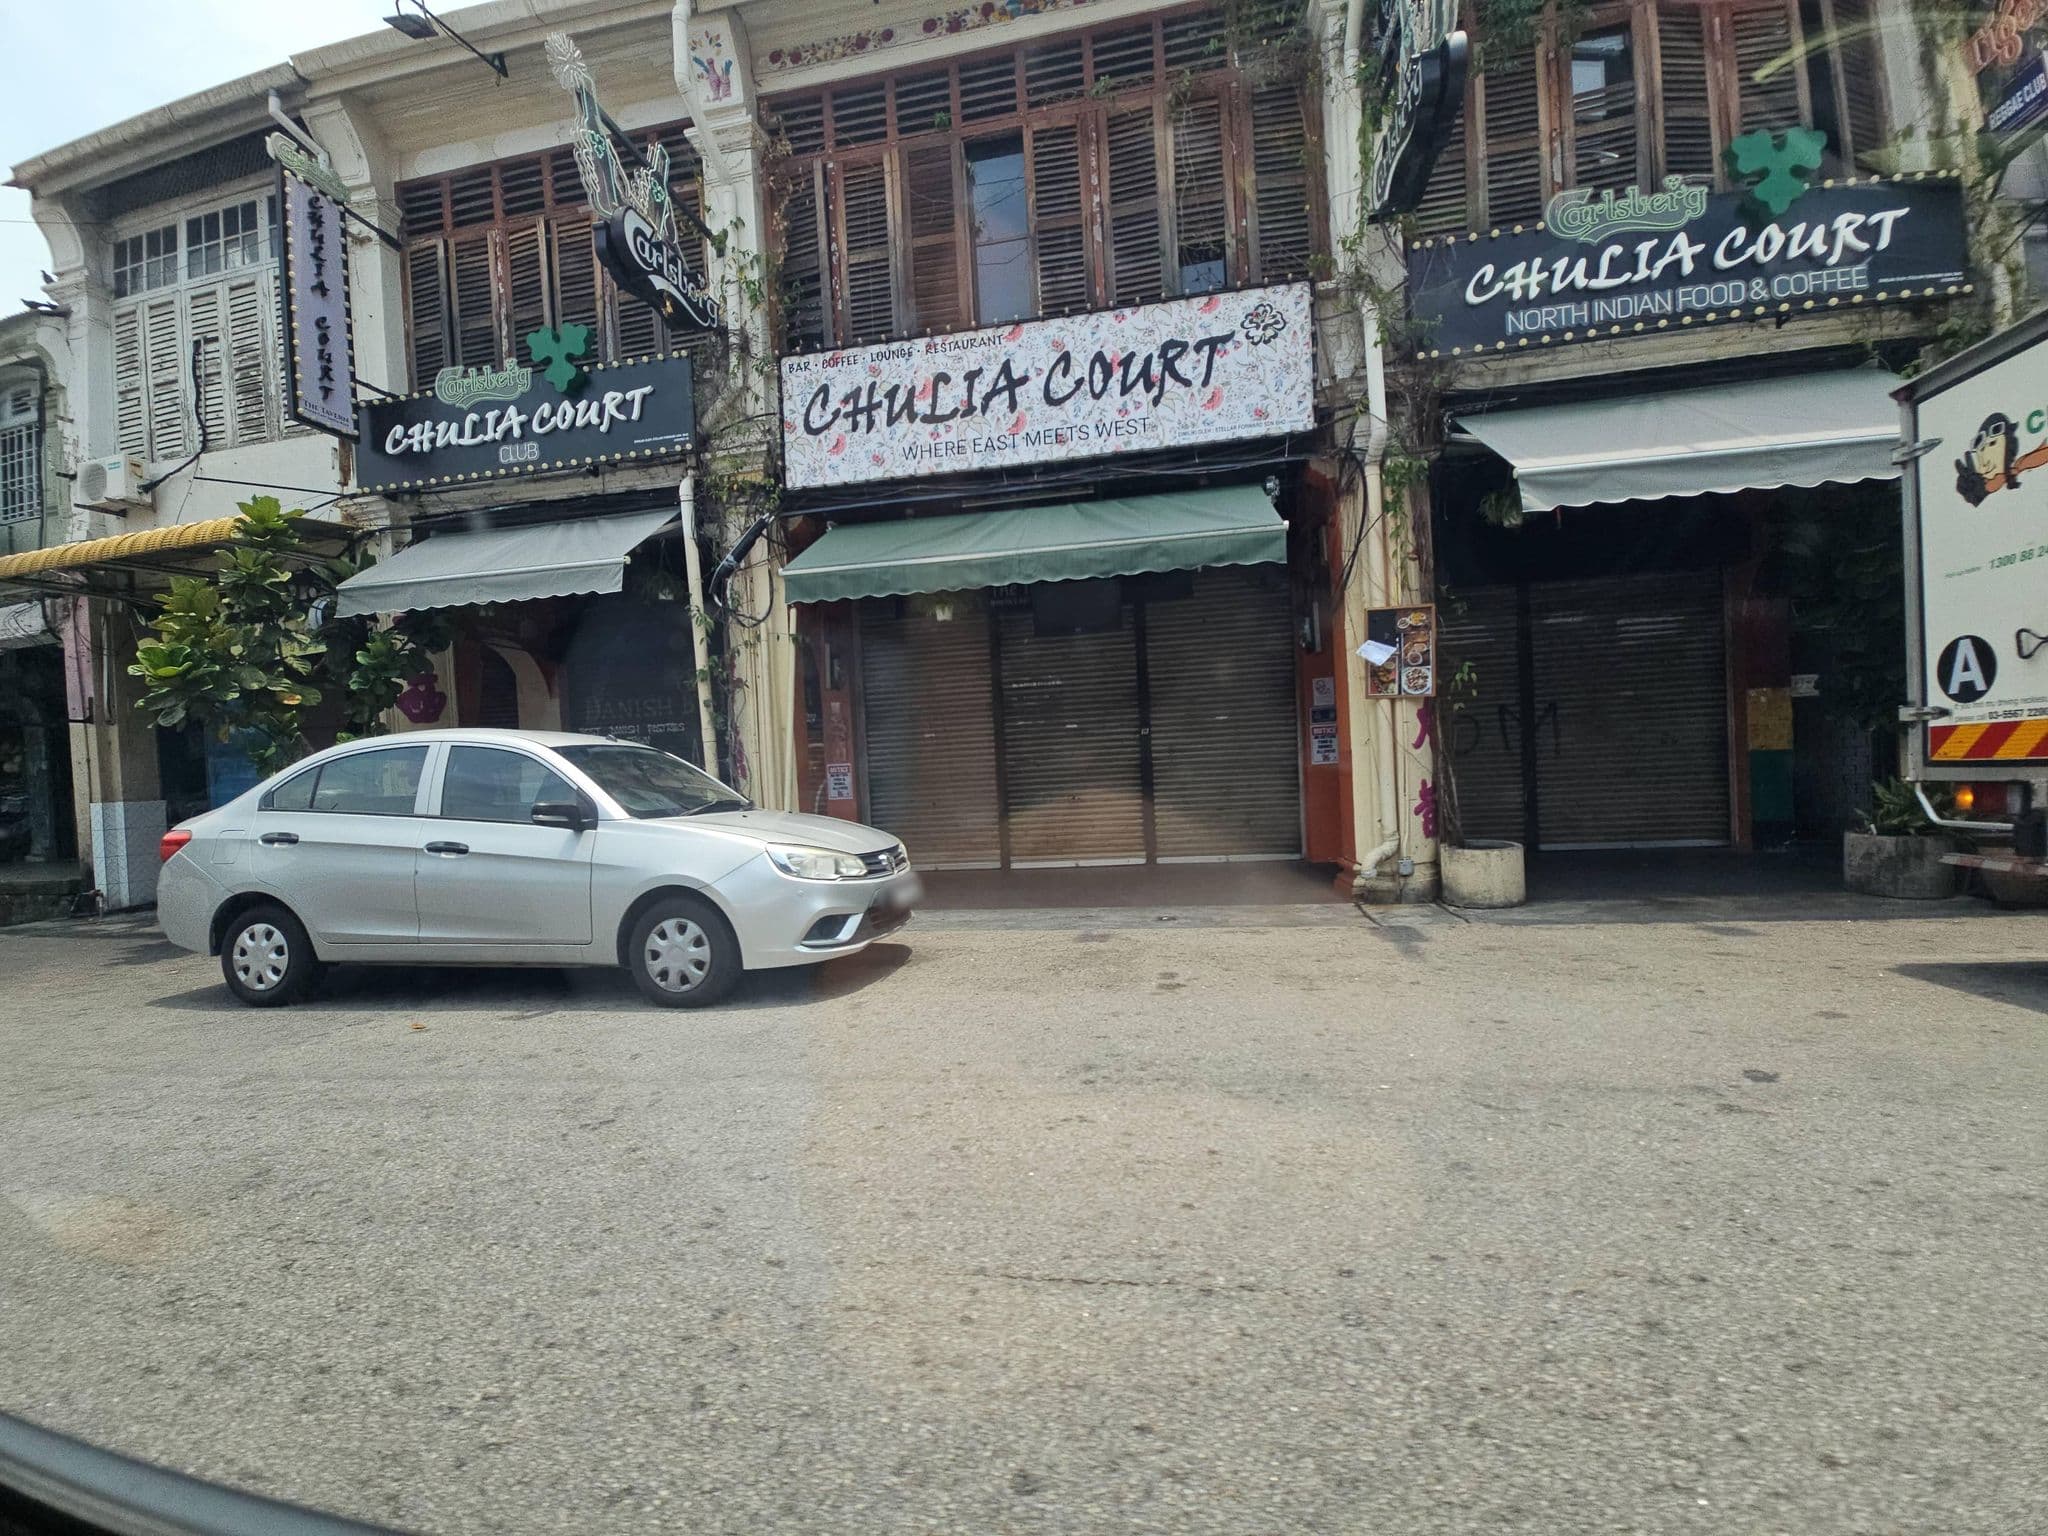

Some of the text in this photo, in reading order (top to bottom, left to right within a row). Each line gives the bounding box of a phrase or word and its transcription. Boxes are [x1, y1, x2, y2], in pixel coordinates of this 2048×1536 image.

[2023, 73, 2047, 102] CLUB
[1548, 175, 1708, 246] Carlsberg
[622, 205, 719, 328] Carlsberg
[1465, 207, 1911, 305] CHULIA COURT
[1506, 265, 1870, 335] NORTH INDIAN FOOD & COFFEE
[314, 316, 335, 401] COURT
[435, 358, 533, 410] Carlsberg
[788, 334, 1004, 374] BAR COFFEE LOUNGE RESTAURANT
[803, 330, 1236, 436] CHULIA COURT
[385, 385, 655, 455] CHULIA COURT
[499, 441, 540, 465] CLUB
[903, 417, 1151, 461] WHERE EAST MEETS WEST
[1947, 637, 1988, 694] A
